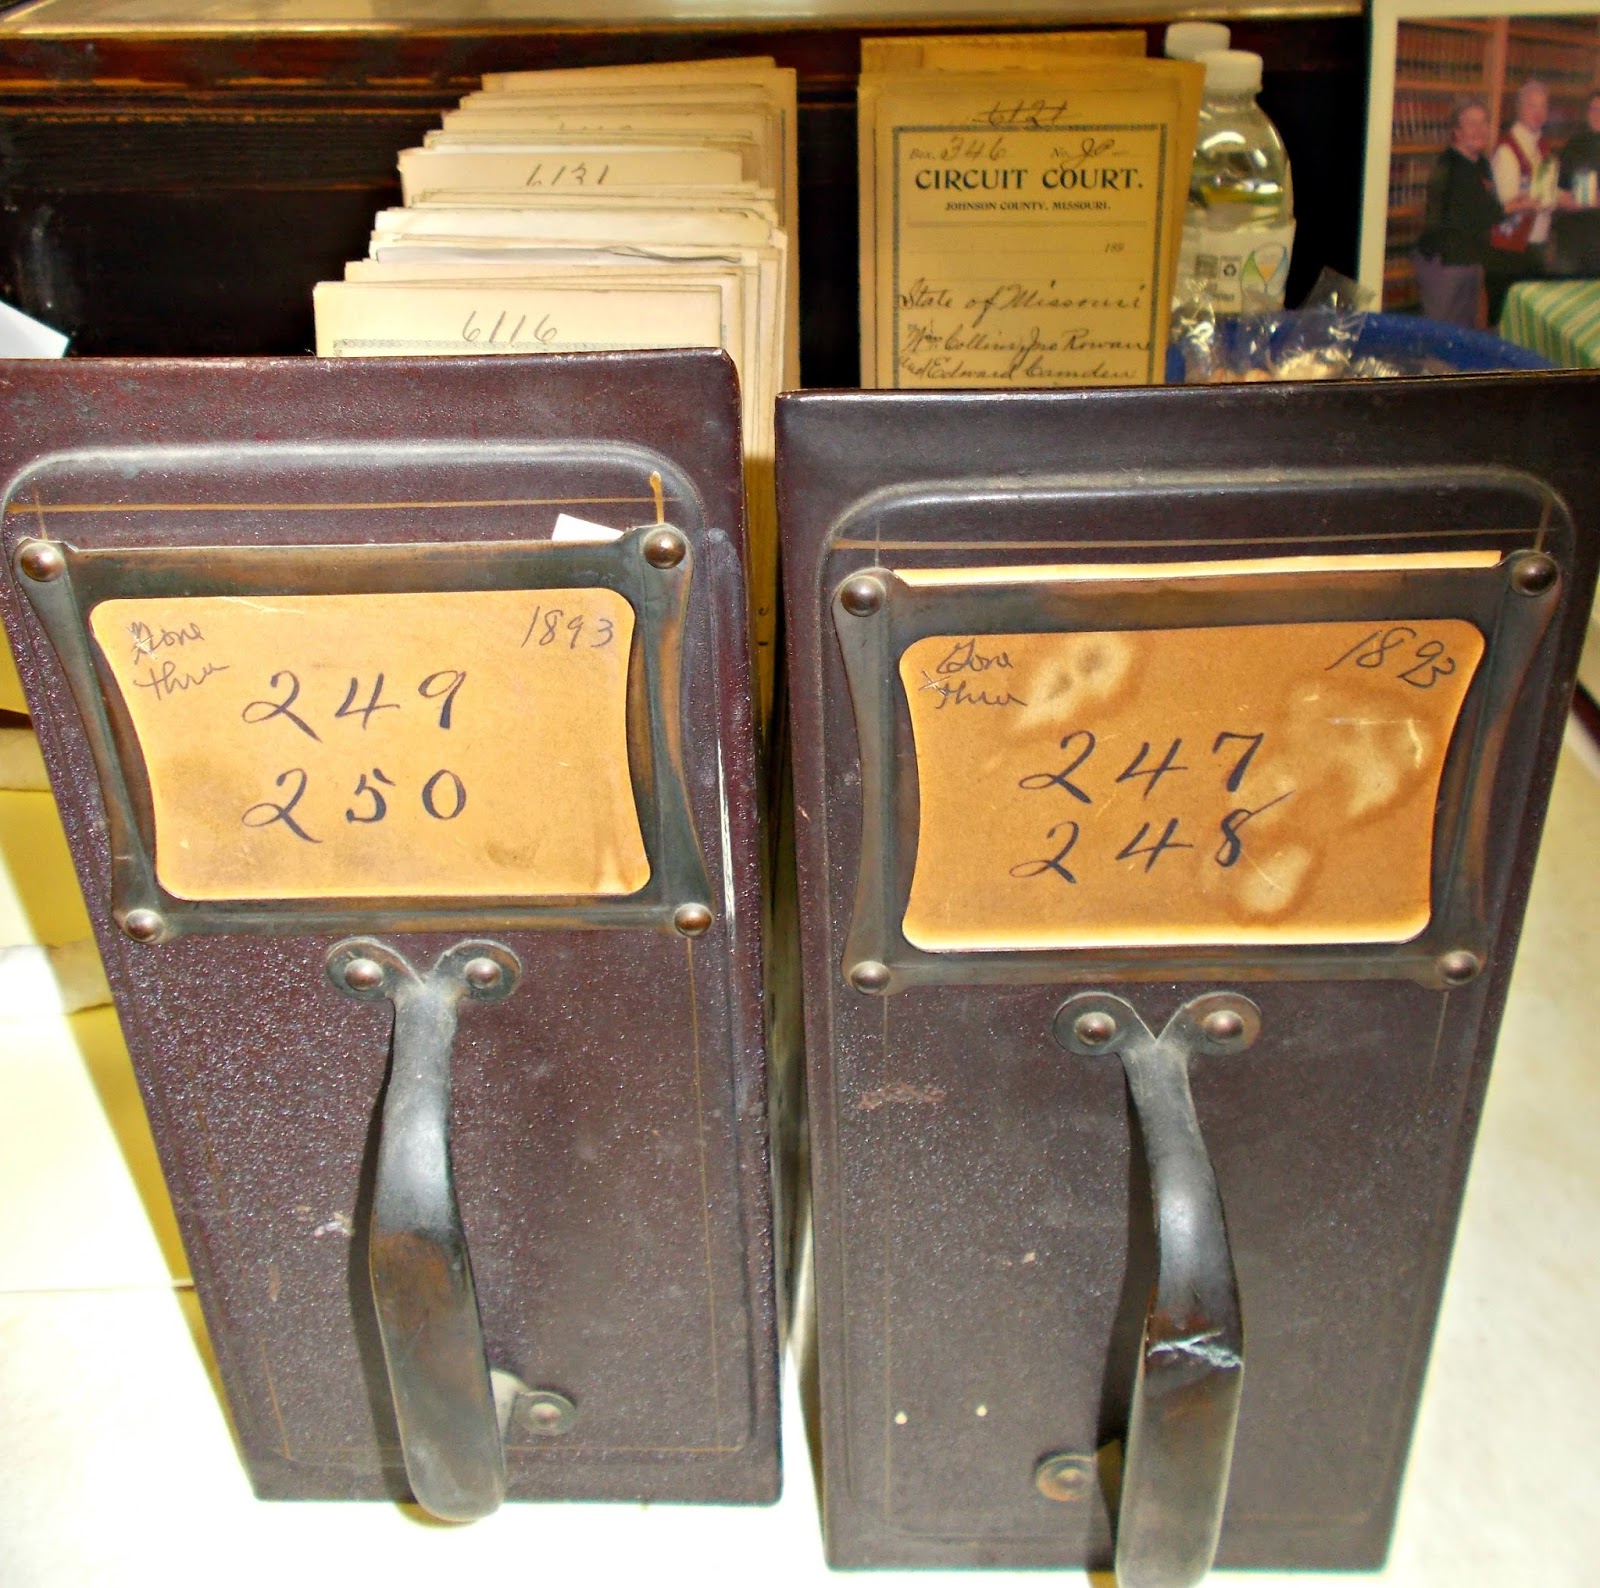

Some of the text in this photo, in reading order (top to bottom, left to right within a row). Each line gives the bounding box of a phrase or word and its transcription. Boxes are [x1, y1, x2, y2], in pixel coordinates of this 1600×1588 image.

[915, 168, 1144, 191] CIRCUIT COURT.
[945, 201, 997, 211] JOHNSON
[899, 277, 954, 310] State
[965, 285, 1005, 328] of
[462, 310, 558, 347] 6116
[521, 605, 617, 650] 1893
[241, 669, 468, 742] 249
[1018, 729, 1265, 804] 247
[241, 767, 468, 844] 250
[1008, 790, 1296, 884] 248
